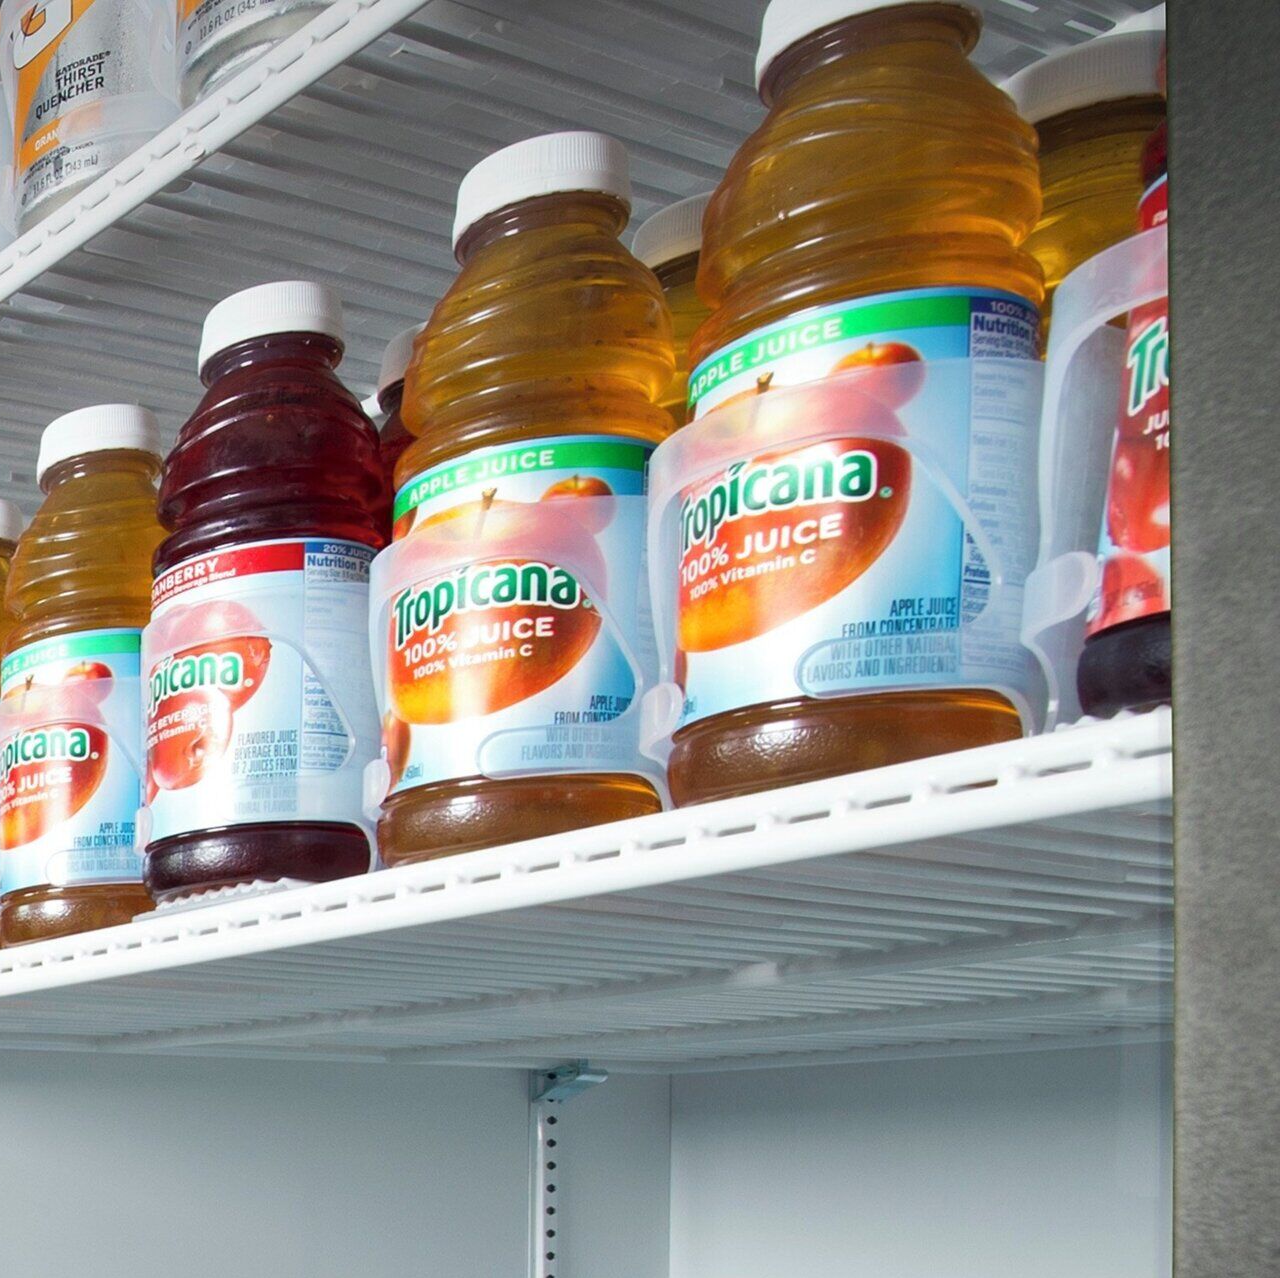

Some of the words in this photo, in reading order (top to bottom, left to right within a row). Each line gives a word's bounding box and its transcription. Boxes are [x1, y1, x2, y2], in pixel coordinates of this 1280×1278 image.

[56, 61, 105, 90] THIRST
[35, 77, 105, 119] QUENCHER
[972, 316, 1031, 341] Nutrition
[690, 356, 745, 401] APPLE
[751, 317, 843, 364] JUICE
[409, 466, 469, 505] APPLE
[475, 450, 555, 477] JUICE
[679, 453, 872, 566] Tropicana
[681, 544, 729, 587] 100%
[735, 513, 843, 560] JUICE
[307, 555, 357, 572] Nutrition
[689, 577, 719, 601] 100%
[720, 553, 796, 586] Vitamin
[801, 548, 817, 564] C
[395, 565, 579, 648] Tropicana
[890, 600, 925, 617] APPLE
[928, 597, 956, 615] JUICE
[842, 619, 876, 637] FROM
[880, 616, 957, 635] CONCENTRATE
[404, 632, 457, 666] 100%
[461, 616, 555, 649] JUICE
[831, 639, 860, 659] WITH
[864, 637, 898, 658] OTHER
[901, 634, 957, 656] NATURAL
[413, 663, 446, 679] 100%
[449, 647, 516, 669] Vitamin
[519, 643, 533, 658] C
[855, 659, 880, 679] AND
[883, 655, 957, 678] INGREDIENTS
[590, 697, 613, 710] APPLE
[555, 711, 580, 726] FROM
[160, 721, 194, 742] Vitamin
[238, 732, 274, 744] FLAVORED
[276, 730, 297, 743] JUICE
[546, 728, 570, 742] WITH
[235, 746, 271, 760] BEVERAGE
[274, 744, 297, 757] BLEND
[522, 744, 563, 760] FLAVORS
[565, 743, 586, 759] AND
[248, 760, 272, 773] JUICES
[274, 758, 297, 771] FROM
[17, 766, 73, 793] JUICE
[74, 835, 91, 848] FROM
[94, 834, 134, 848] CONCENTRAT
[99, 823, 118, 835] APPLE
